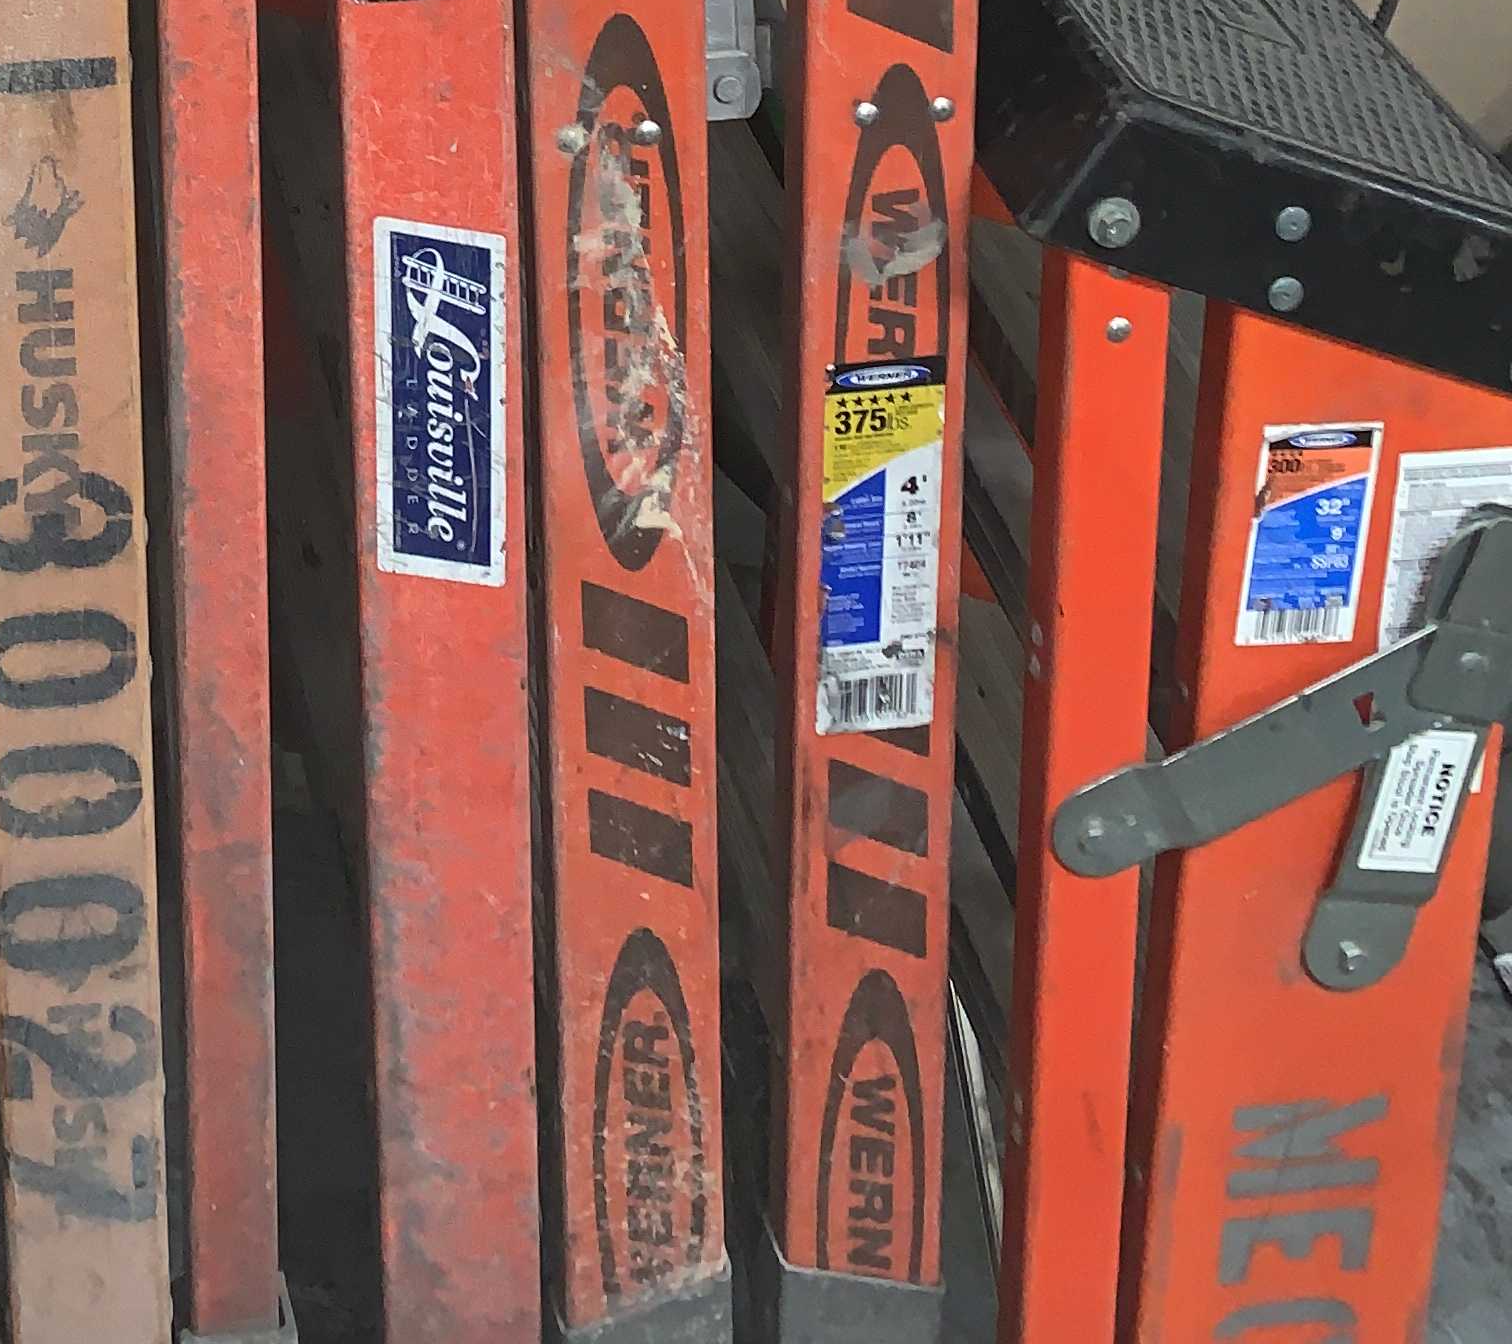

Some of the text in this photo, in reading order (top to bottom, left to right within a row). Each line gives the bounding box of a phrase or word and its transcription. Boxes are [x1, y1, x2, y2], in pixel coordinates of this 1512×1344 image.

[14, 267, 83, 529] HUSKY
[402, 246, 487, 544] Louisville
[835, 408, 887, 435] 375
[1269, 458, 1302, 474] 300
[1421, 763, 1456, 838] NOTICE
[846, 1073, 897, 1273] WERN
